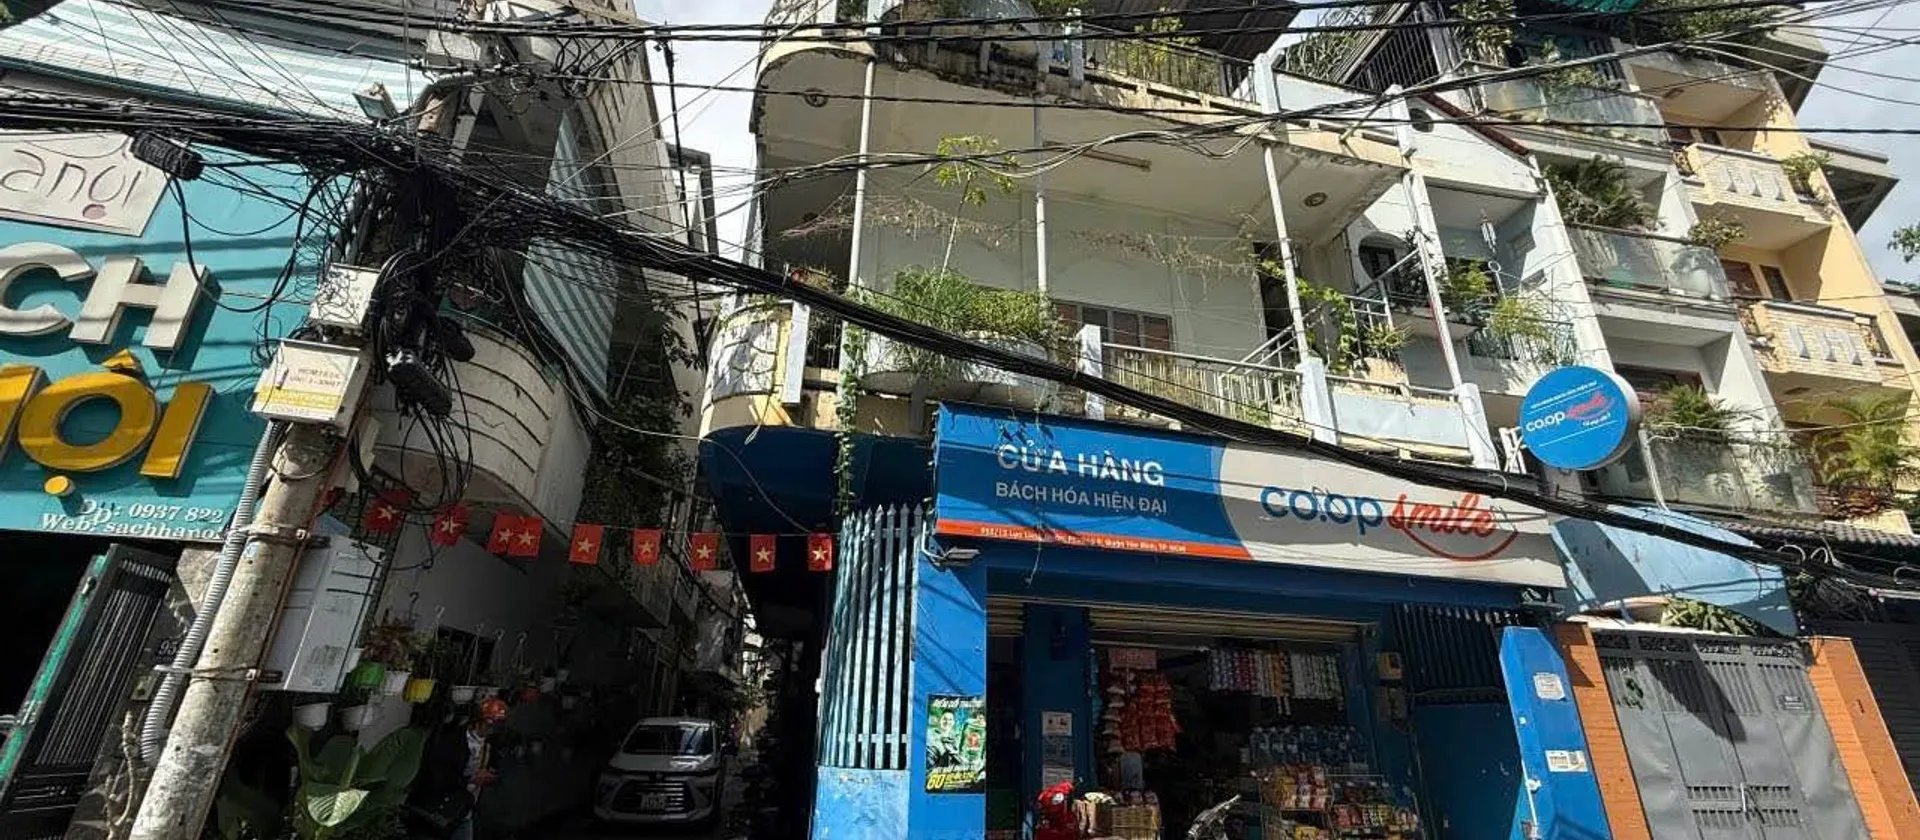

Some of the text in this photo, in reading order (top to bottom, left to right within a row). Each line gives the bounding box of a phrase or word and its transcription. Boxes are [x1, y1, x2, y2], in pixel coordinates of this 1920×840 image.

[997, 440, 1165, 487] CỬA HÀNG
[129, 503, 181, 521] 0937
[185, 506, 224, 524] 822
[996, 480, 1167, 517] BÁCH HÓA HIỆN ĐẠI
[1259, 485, 1497, 539] co.op smile
